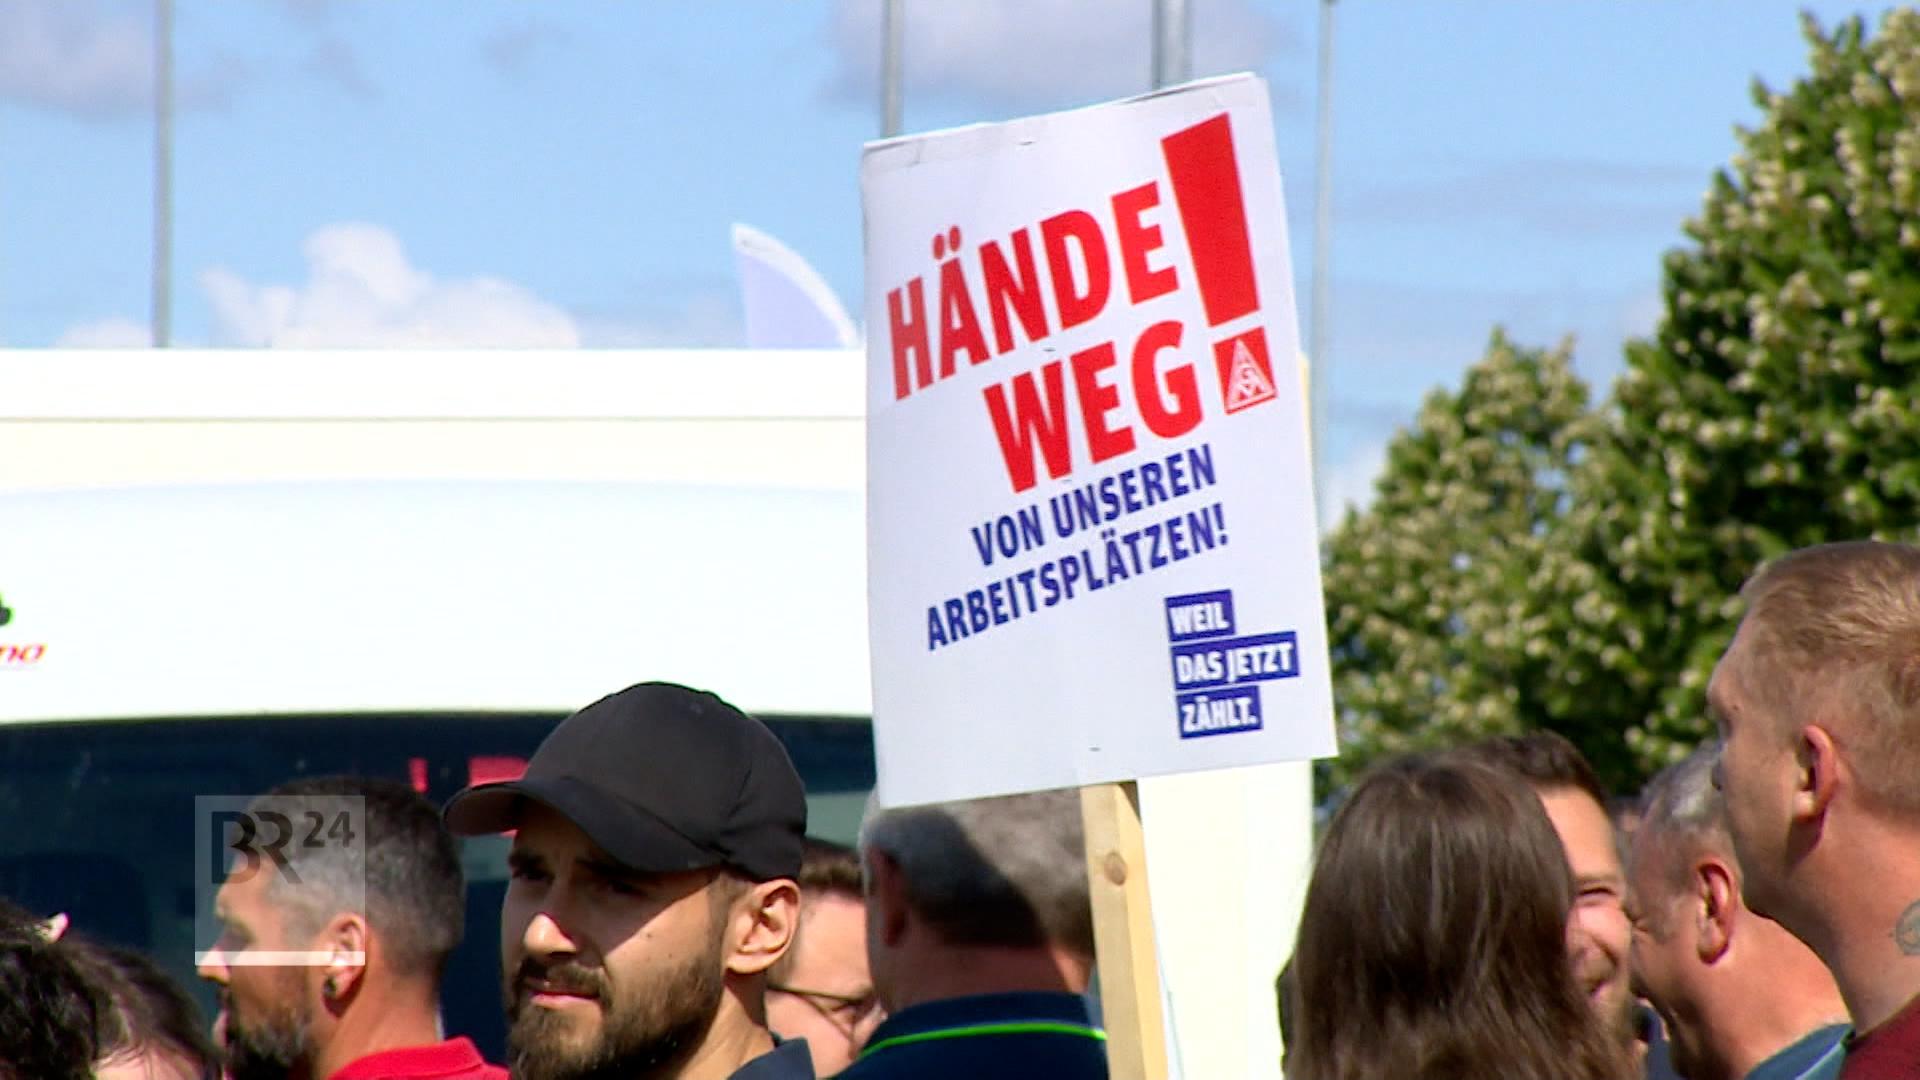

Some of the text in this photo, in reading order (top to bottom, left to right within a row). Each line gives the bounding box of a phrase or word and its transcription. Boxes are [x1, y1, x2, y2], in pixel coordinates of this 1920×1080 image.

[887, 180, 1180, 402] HÄNDE
[982, 320, 1204, 494] WEG
[971, 443, 1217, 566] VON UNSEREN
[926, 503, 1229, 651] ARBEITSPLÄTZEN!
[1169, 601, 1230, 635] WEIL
[1175, 641, 1294, 684] DAS JETZT
[1181, 695, 1259, 734] ZÄHLT.
